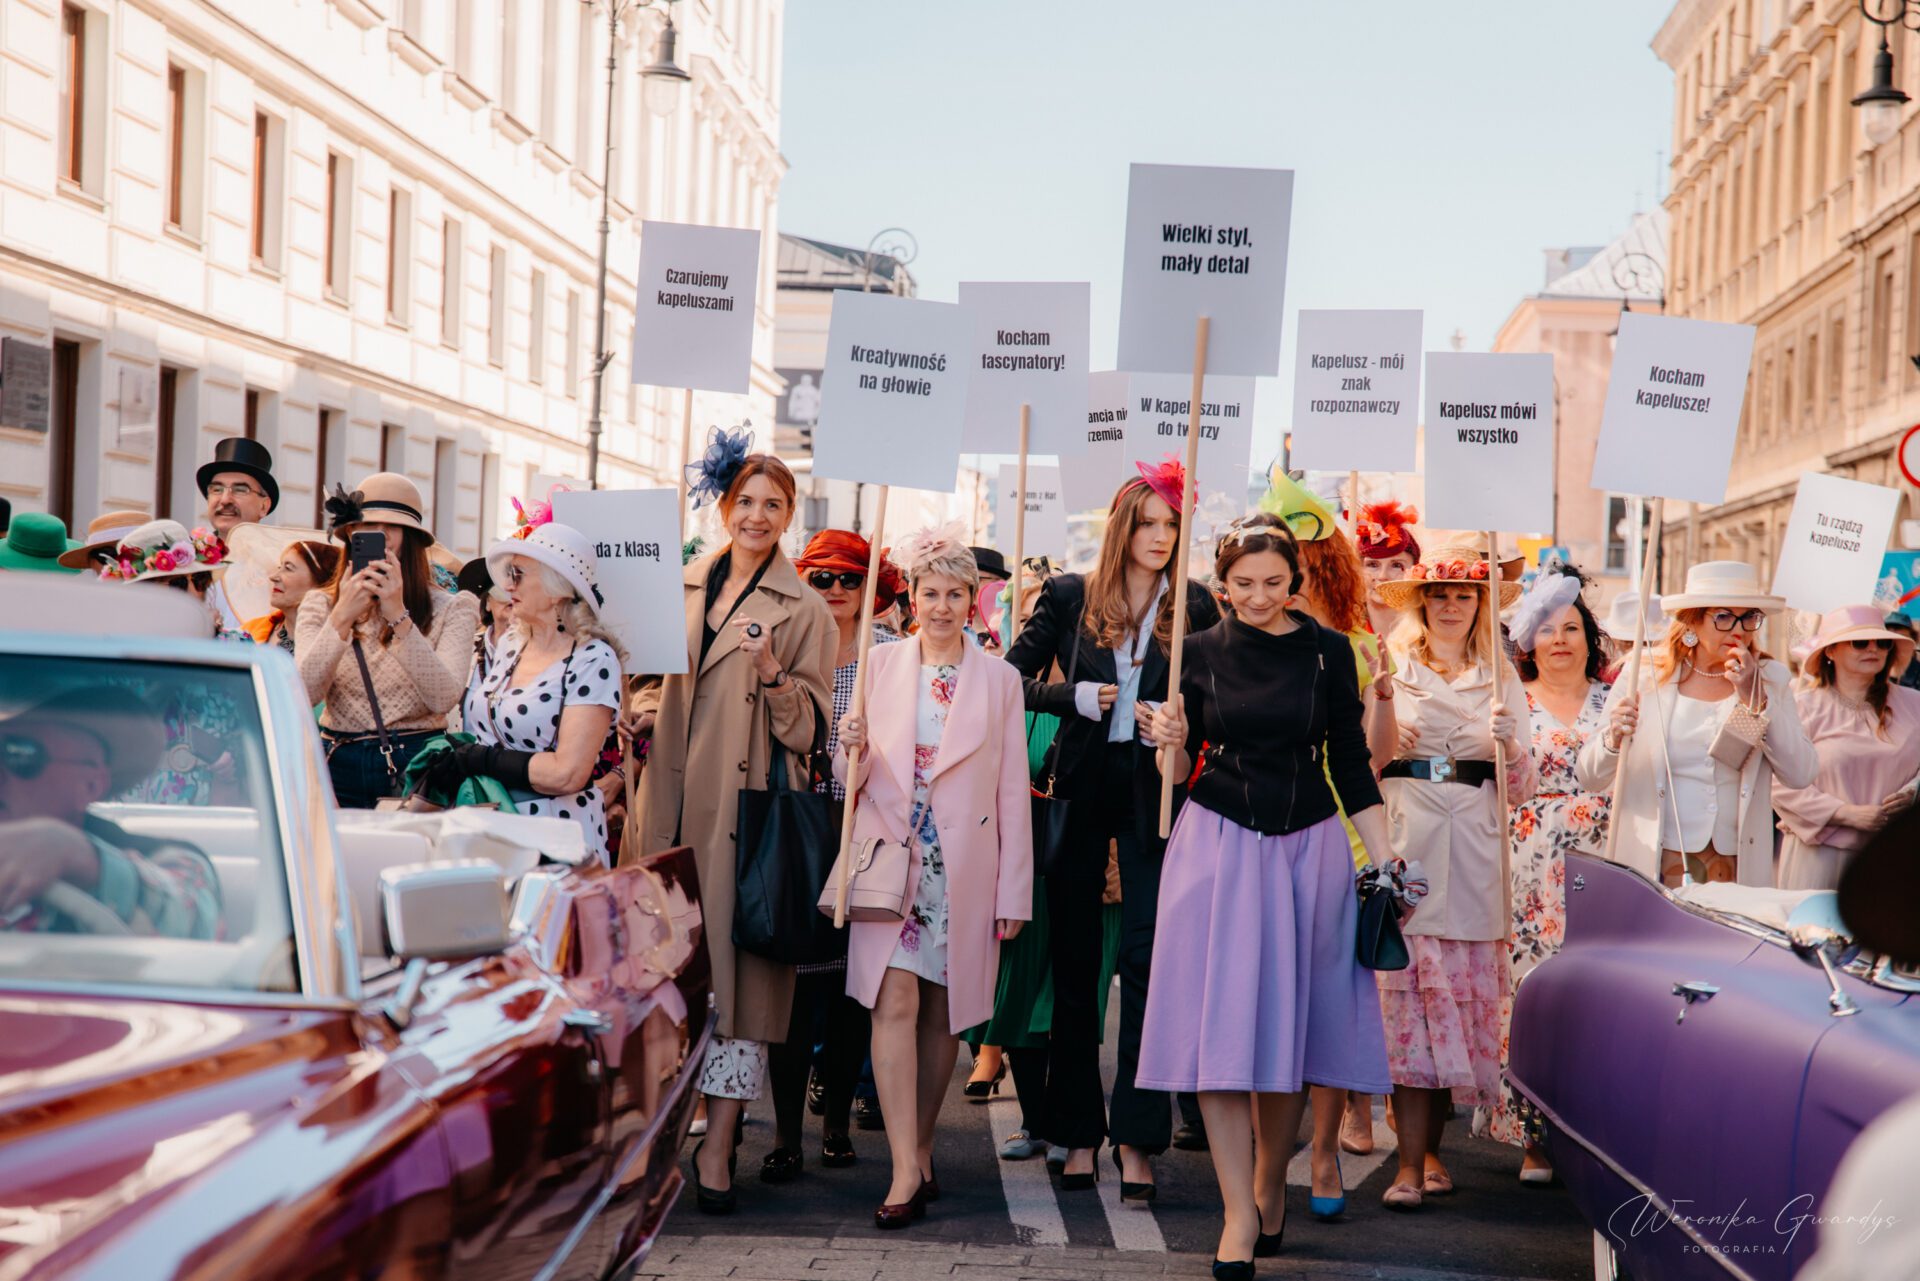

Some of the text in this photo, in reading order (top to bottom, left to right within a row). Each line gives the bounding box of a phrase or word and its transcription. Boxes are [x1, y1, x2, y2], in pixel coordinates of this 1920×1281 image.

[1162, 223, 1252, 248] Wielki styl,
[1161, 253, 1249, 275] mały detal
[666, 268, 728, 290] Czarujemy
[657, 290, 734, 312] kapeluszami
[997, 330, 1050, 346] Kocham
[851, 344, 946, 372] Kreatywność
[982, 353, 1065, 371] fascynatory!
[1311, 354, 1368, 371] Kapelusz
[1380, 353, 1405, 370] mój
[859, 374, 931, 396] na głowie
[1341, 376, 1371, 391] znak
[1649, 366, 1705, 387] Kocham
[1141, 397, 1241, 418] W kapelszu mi
[1310, 399, 1400, 415] rozpoznawczy
[1440, 402, 1536, 420] Kapelusz mówi
[1635, 389, 1711, 413] kapelusze!
[1088, 408, 1114, 423] ancja
[1088, 427, 1123, 442] rzemija
[1157, 420, 1220, 441] do twrzy
[1457, 427, 1519, 445] wszystko
[1817, 512, 1863, 538] Tu rządzą
[592, 541, 660, 562] da z klasą
[1809, 530, 1861, 552] kapelusze
